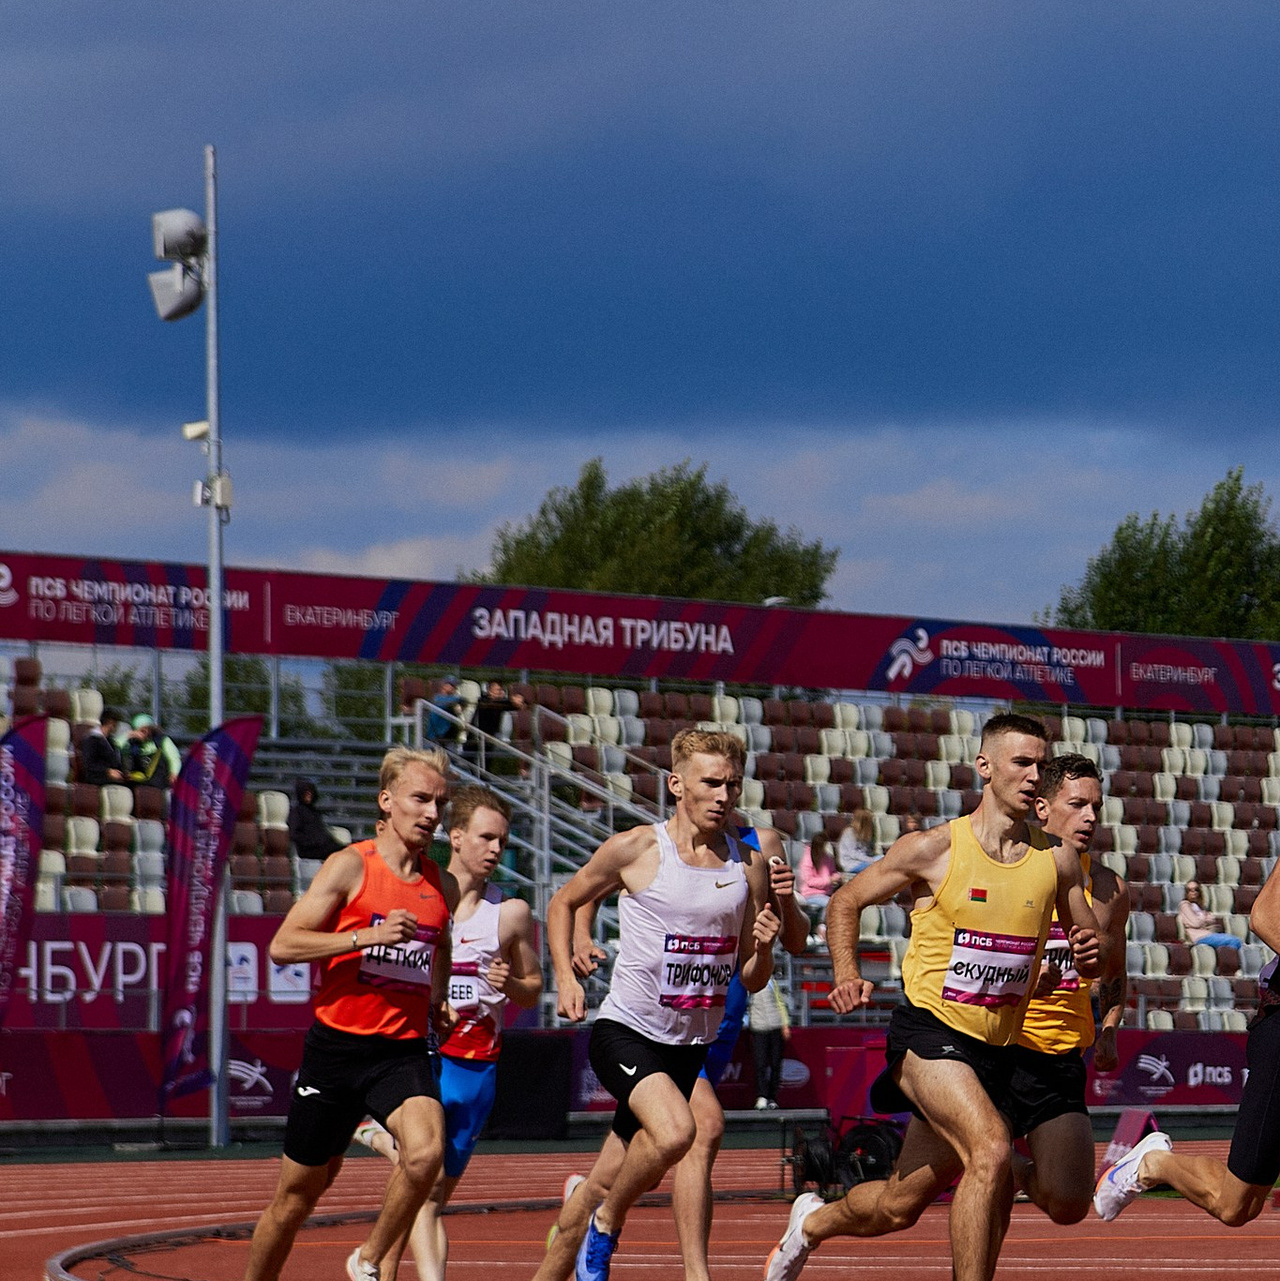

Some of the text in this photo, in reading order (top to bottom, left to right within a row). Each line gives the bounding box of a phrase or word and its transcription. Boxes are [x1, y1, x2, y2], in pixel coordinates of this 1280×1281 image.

[28, 576, 250, 611] ПСБ ЧЕМПИОНАТ РОСИИ
[29, 599, 209, 631] ПО ЛЕГКОЙ АТЛЕТИКЕ
[283, 604, 400, 631] ЕКАТЕРИНБУРГ
[471, 606, 735, 655] ЗАПАДНАЯ ТРИБУНА
[940, 639, 1105, 668] ПСБ ЧЕМПИОНАТ РОССИИ
[940, 658, 1075, 685] ПО ЛЕГКОЙ АТЛЕТИКЕ
[1130, 662, 1217, 685] ЕКАТЕРИНБУРГ
[681, 941, 700, 950] ПСБ
[971, 933, 993, 947] ПСБ
[666, 963, 732, 987] ТРИФОНОВ
[953, 961, 1030, 986] СКУДНЫЙ
[448, 984, 474, 1000] ЕЕВ
